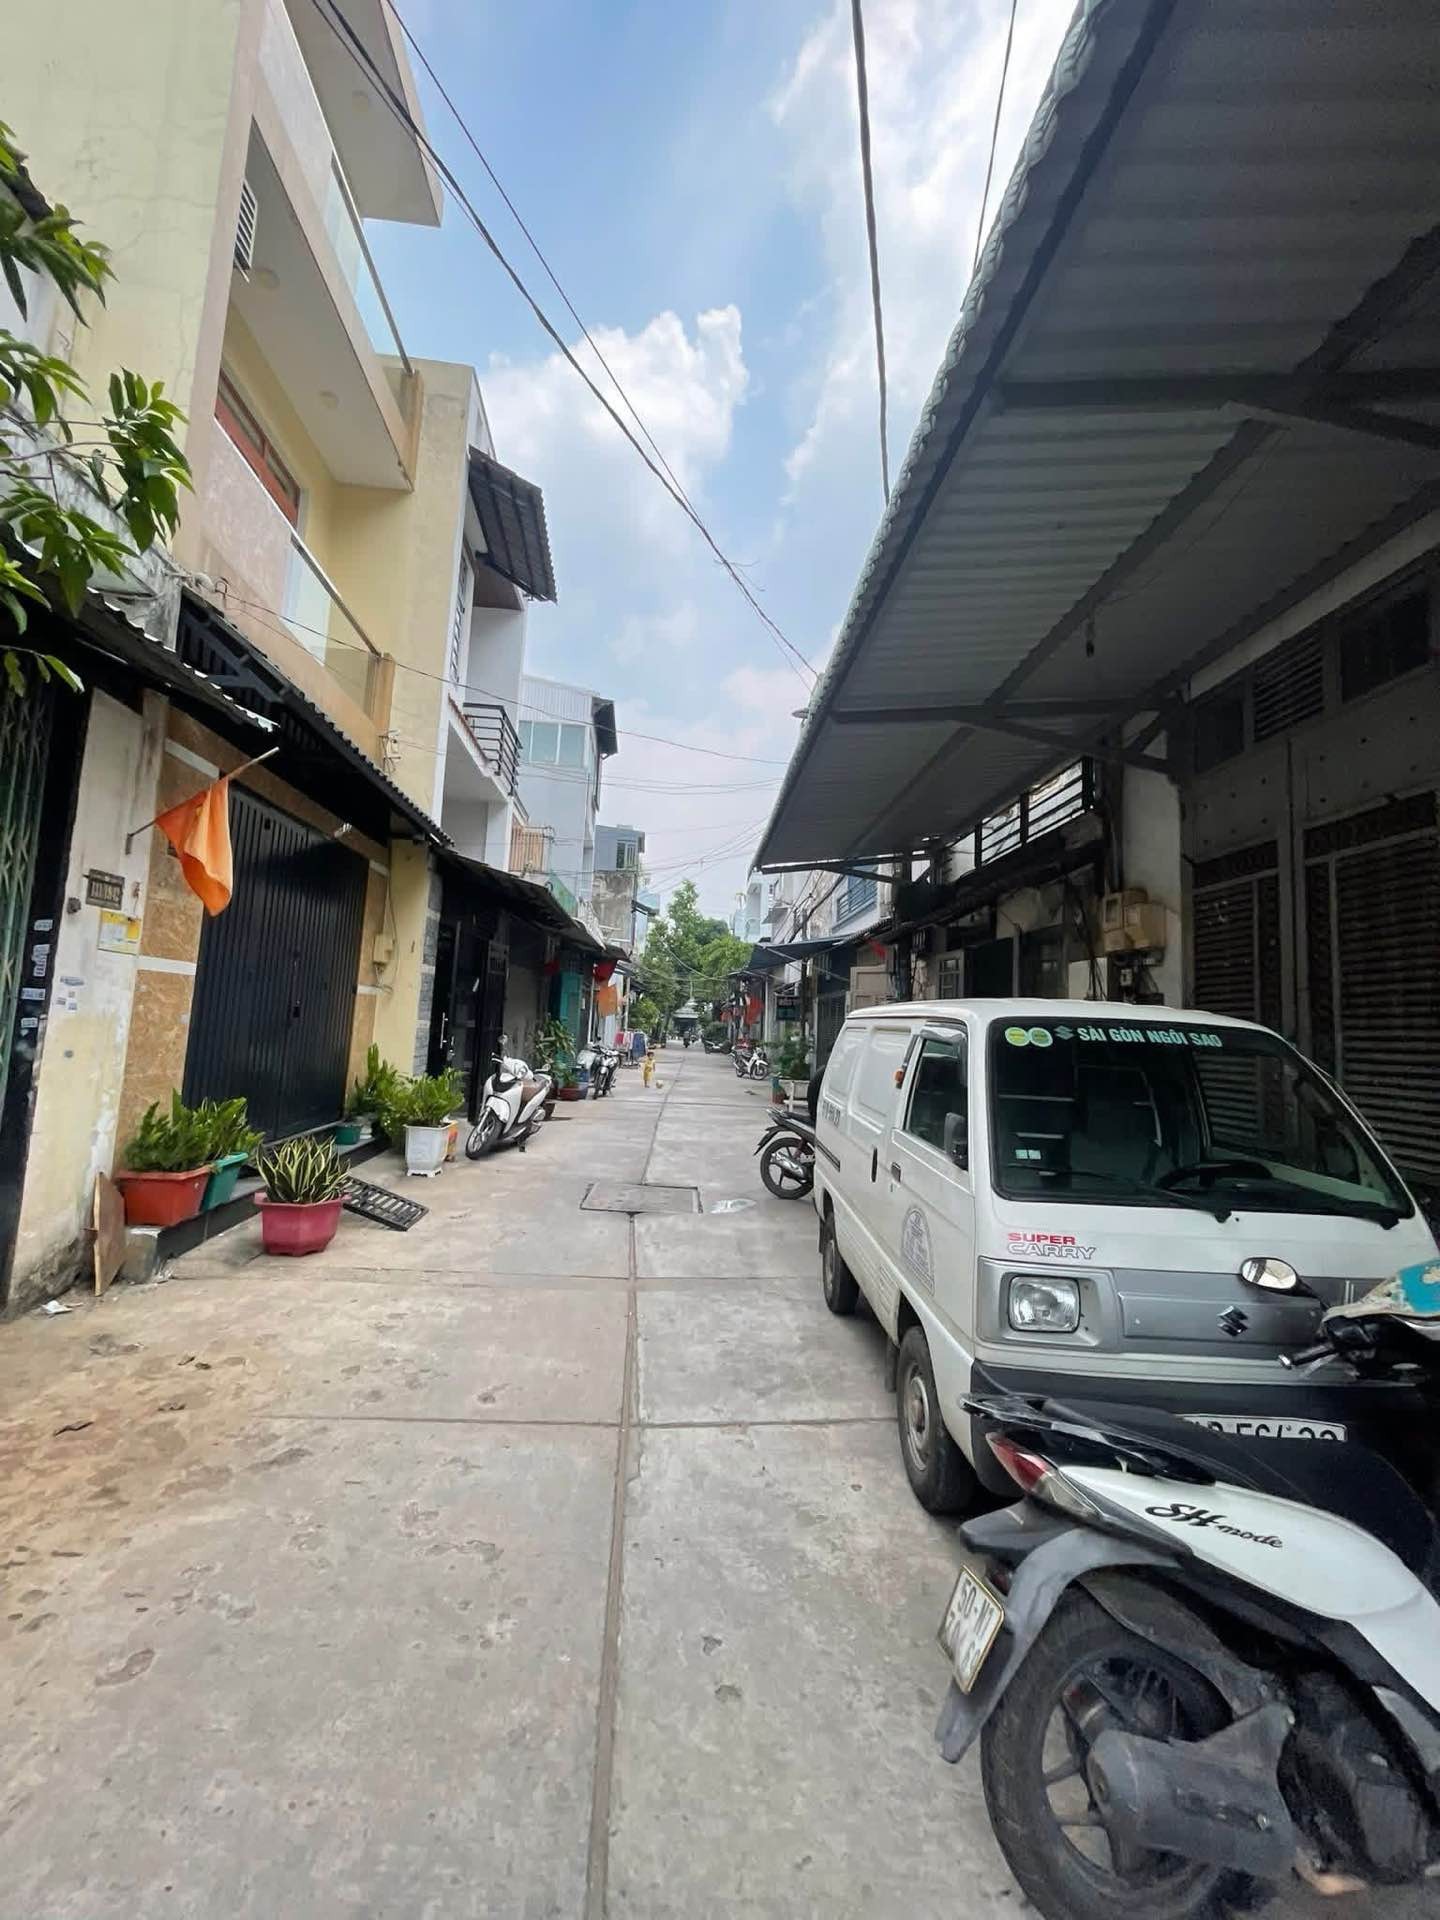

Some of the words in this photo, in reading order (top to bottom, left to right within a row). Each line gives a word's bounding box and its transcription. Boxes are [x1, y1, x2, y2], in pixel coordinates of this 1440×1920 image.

[1076, 1025, 1107, 1042] SÀI
[1111, 1027, 1145, 1043] GÒN
[1149, 1028, 1188, 1046] NGÔI
[1190, 1033, 1223, 1048] SAO
[1008, 1232, 1076, 1246] SUPER
[1007, 1243, 1096, 1260] CARRY
[1145, 1503, 1227, 1527] SH
[1215, 1524, 1284, 1548] mode
